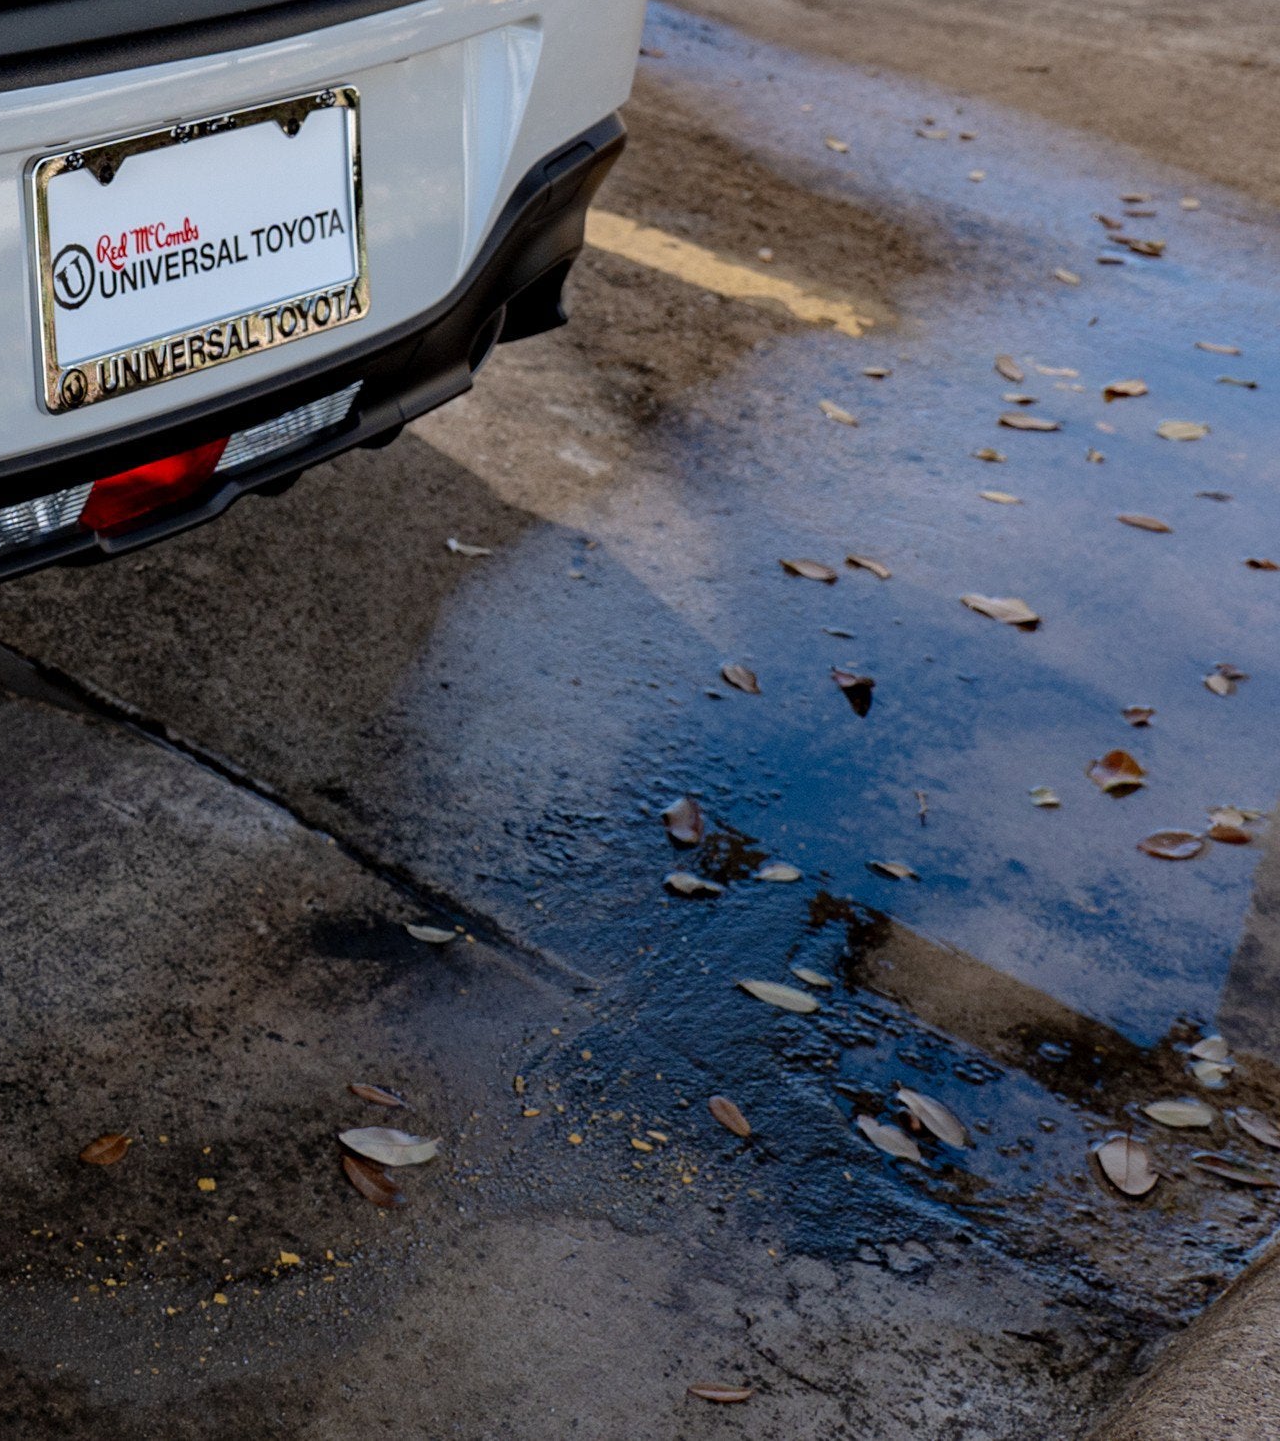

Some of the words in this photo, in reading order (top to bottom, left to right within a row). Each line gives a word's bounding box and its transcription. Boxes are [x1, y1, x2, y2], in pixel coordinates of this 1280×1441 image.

[96, 232, 128, 270] Red
[130, 217, 199, 255] McCombs
[99, 235, 248, 298] UNIVERSAL
[251, 208, 345, 257] TOYOTA
[96, 318, 259, 394] UNIVERSAL
[260, 284, 362, 343] TOYOTA
